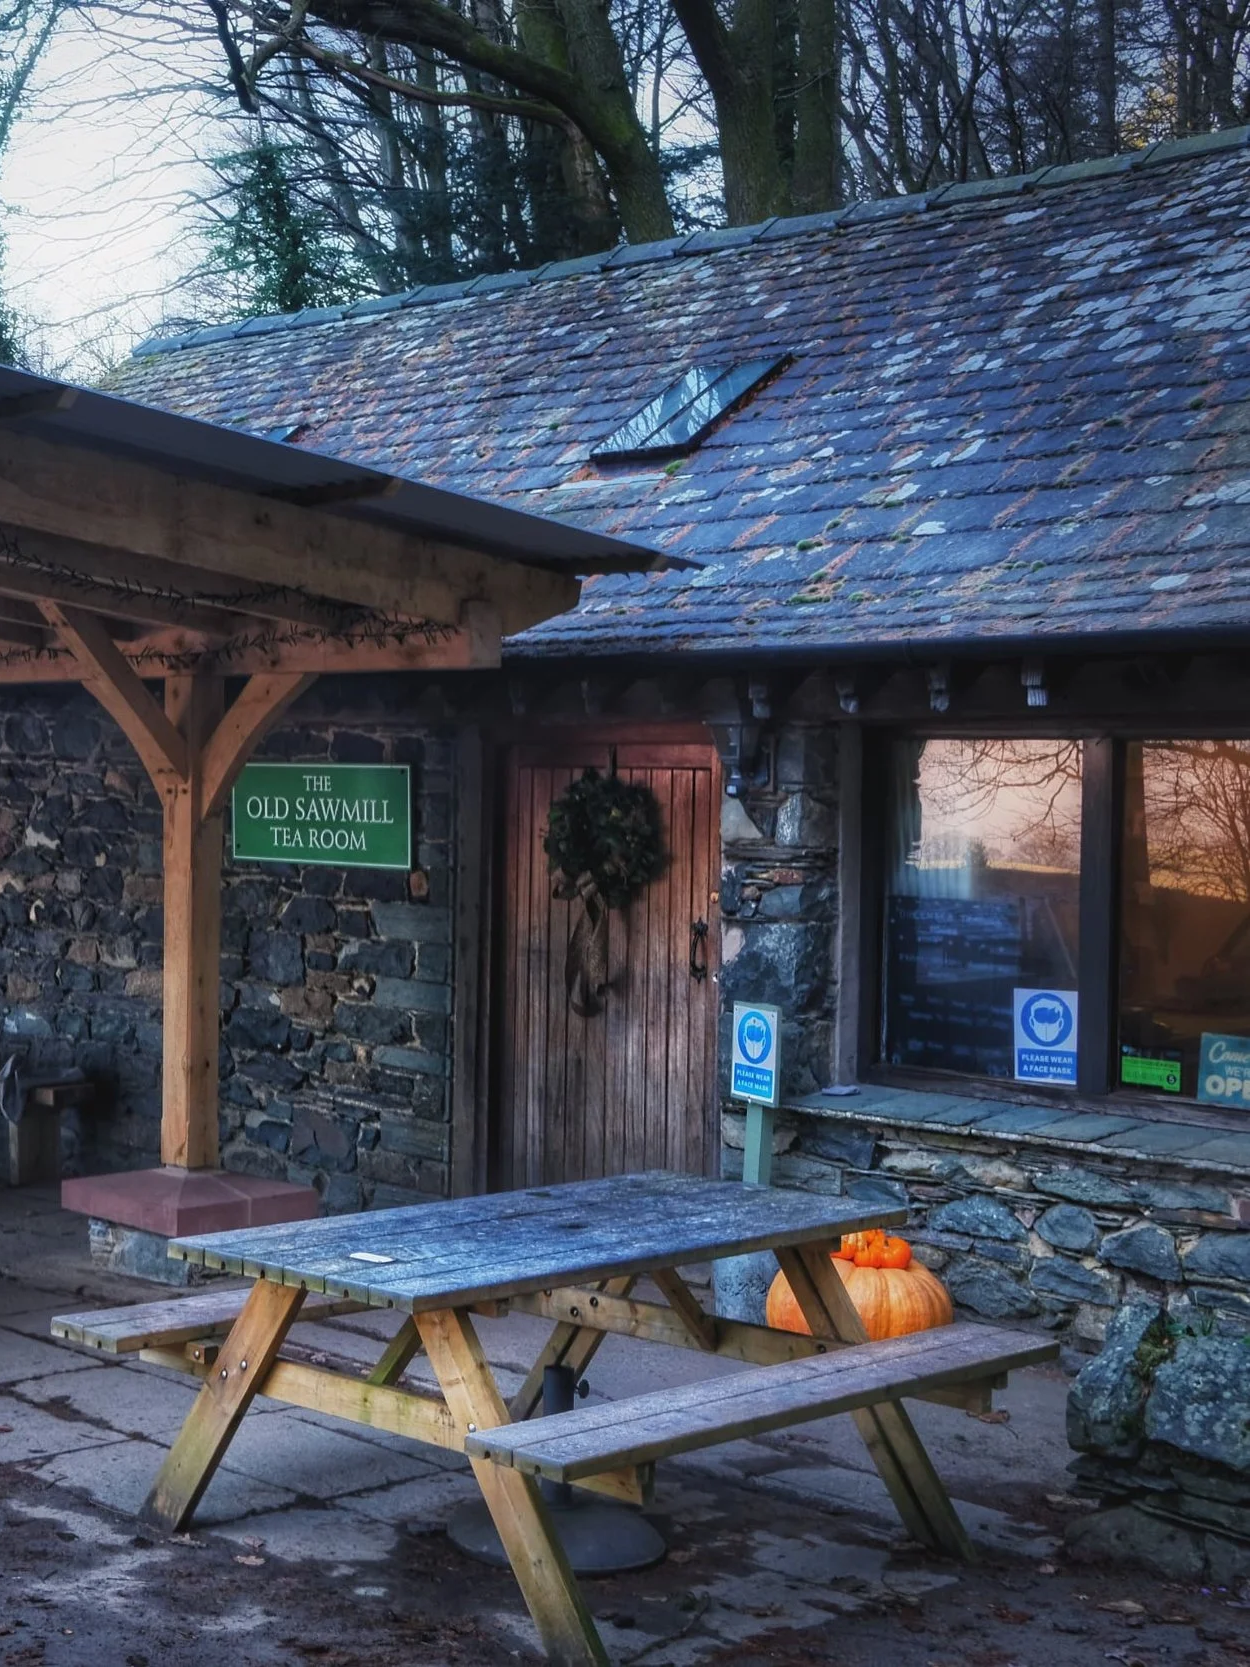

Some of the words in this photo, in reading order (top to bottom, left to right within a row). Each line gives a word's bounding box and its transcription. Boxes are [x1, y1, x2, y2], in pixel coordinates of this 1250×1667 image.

[302, 775, 332, 791] THE
[246, 796, 289, 819] OLD
[295, 797, 394, 824] SAWMILL
[269, 826, 304, 848] TEA
[308, 828, 367, 851] ROOM
[1021, 1054, 1050, 1063] PLEASE
[1050, 1056, 1073, 1065] WEAR
[737, 1069, 754, 1078] PLEASE
[756, 1073, 770, 1081] WEAR
[1029, 1065, 1049, 1073] FACE
[1049, 1067, 1072, 1075] MASK
[741, 1080, 753, 1088] FACE
[754, 1083, 768, 1091] MASK
